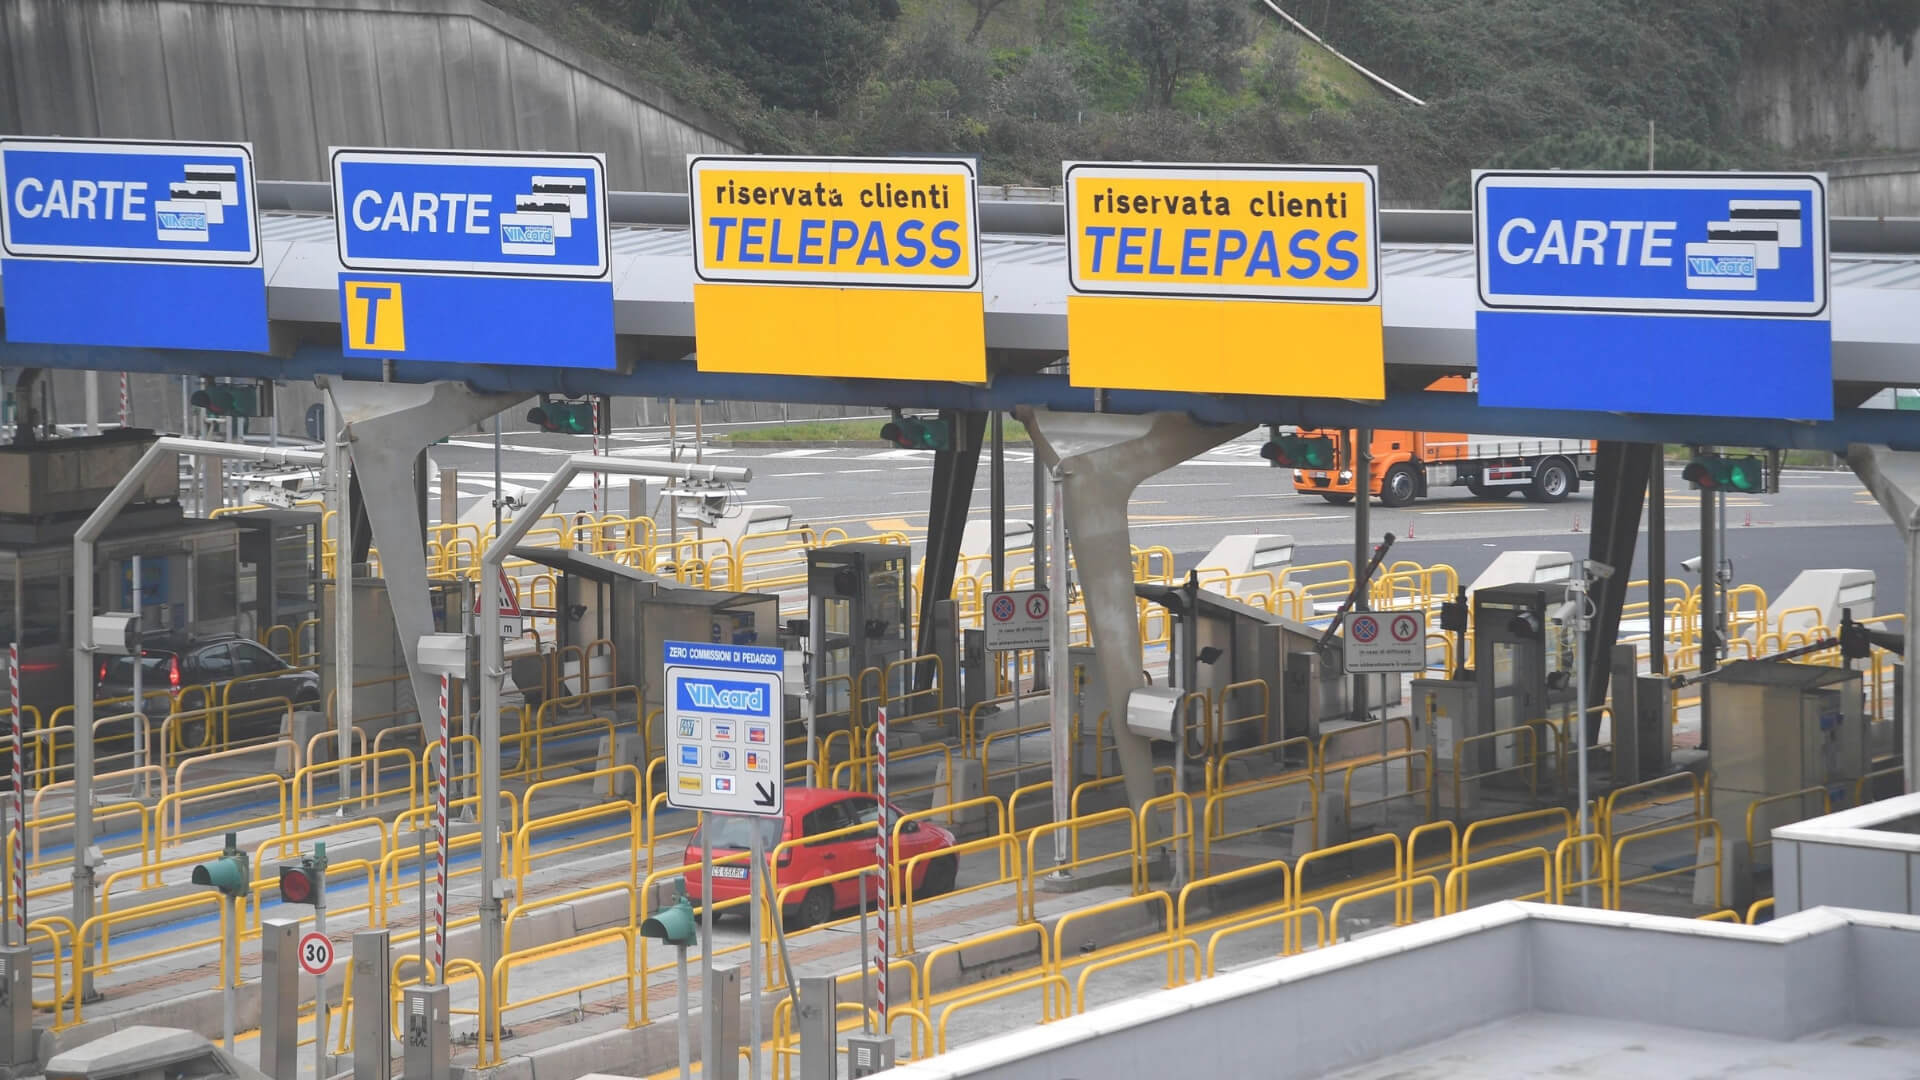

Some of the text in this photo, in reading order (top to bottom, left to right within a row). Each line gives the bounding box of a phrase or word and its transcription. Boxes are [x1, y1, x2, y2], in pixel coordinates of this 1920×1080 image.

[15, 178, 148, 223] CARTE
[352, 190, 493, 236] CARTE
[716, 183, 949, 209] riservata clienti
[1094, 190, 1347, 219] riservata clienti
[709, 216, 961, 268] TELEPASS
[1085, 226, 1359, 281] TELEPASS
[1498, 218, 1677, 267] CARTE
[357, 286, 391, 345] T
[669, 646, 777, 665] ZERO COMMISSIONI DI PEDAGGIO
[685, 683, 763, 712] VIAcard
[306, 944, 326, 964] 30
